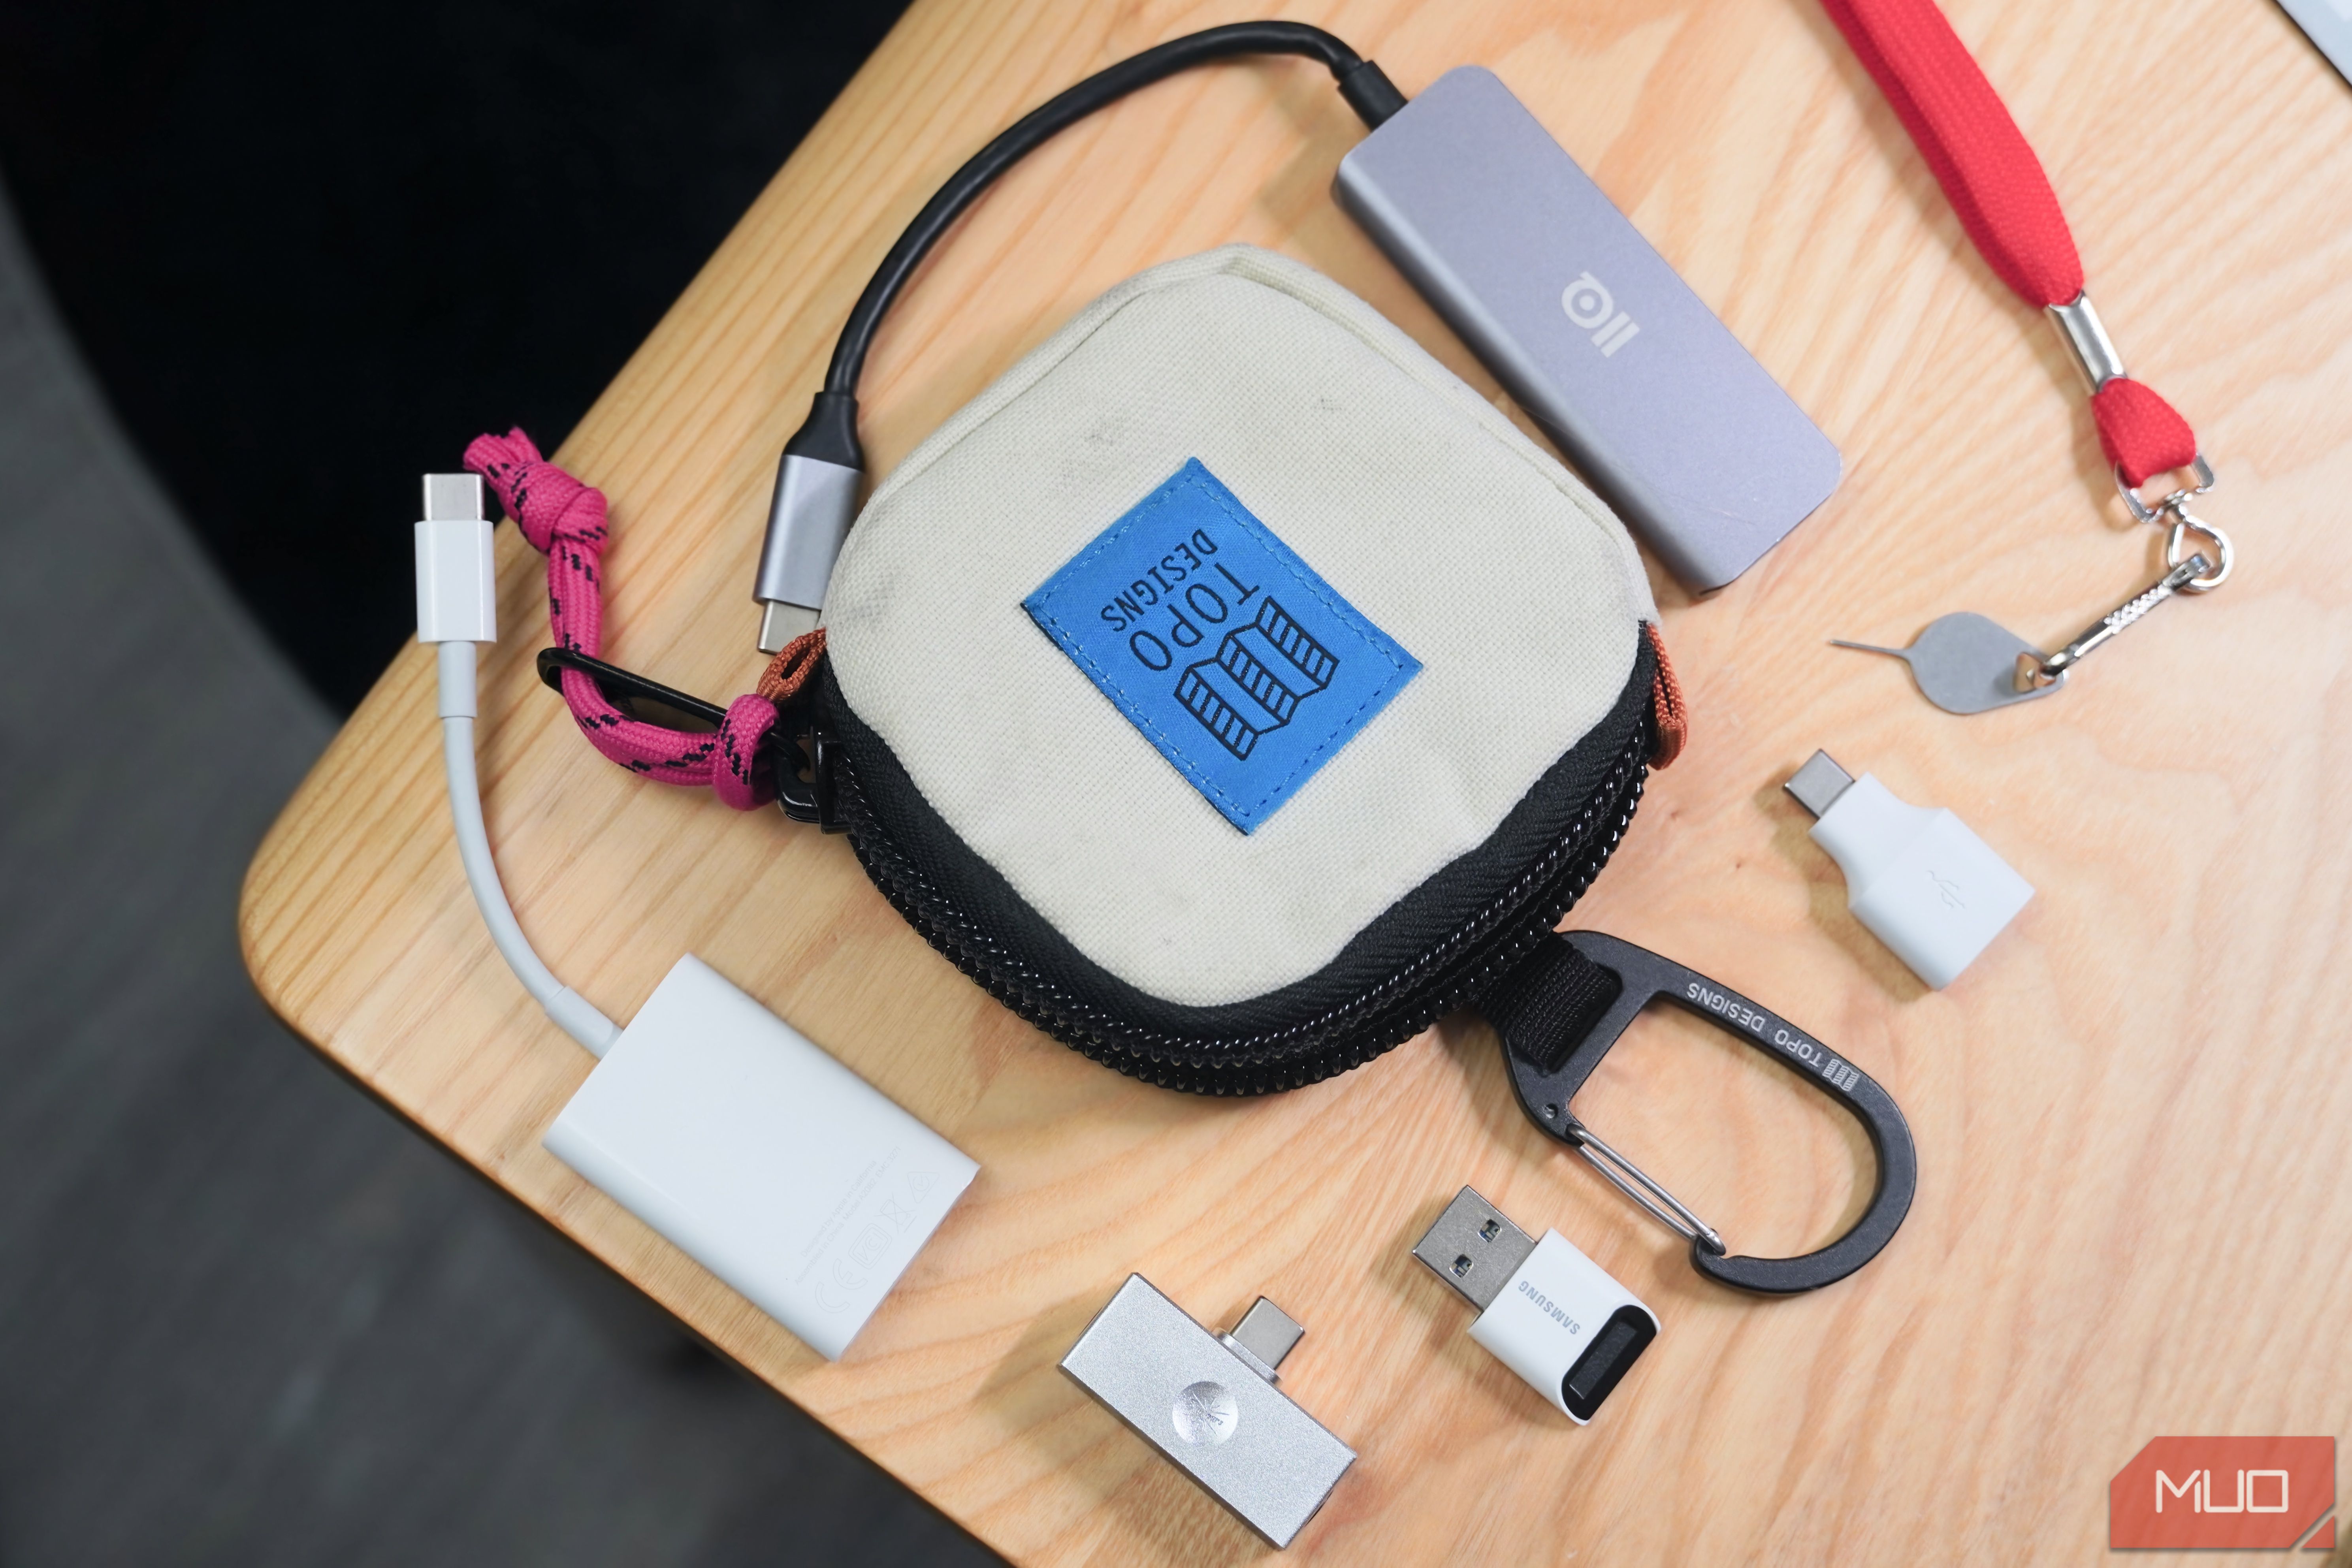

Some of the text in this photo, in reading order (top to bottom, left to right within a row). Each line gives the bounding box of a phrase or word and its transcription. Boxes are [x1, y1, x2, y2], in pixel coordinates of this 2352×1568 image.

[1100, 528, 1218, 632] DESIGNS
[1129, 563, 1260, 672] TOPO
[1687, 983, 1823, 1067] TOPO DESIGNS
[794, 1248, 824, 1286] Assembled
[827, 1222, 844, 1242] China
[842, 1199, 861, 1221] Model
[858, 1178, 877, 1200] A2082
[875, 1161, 890, 1178] EMC
[886, 1145, 901, 1163] 3271
[800, 1225, 827, 1257] Designed
[823, 1216, 834, 1227] by
[831, 1198, 848, 1217] Apple
[850, 1160, 877, 1191] California
[1518, 1280, 1580, 1335] SAMSUNG
